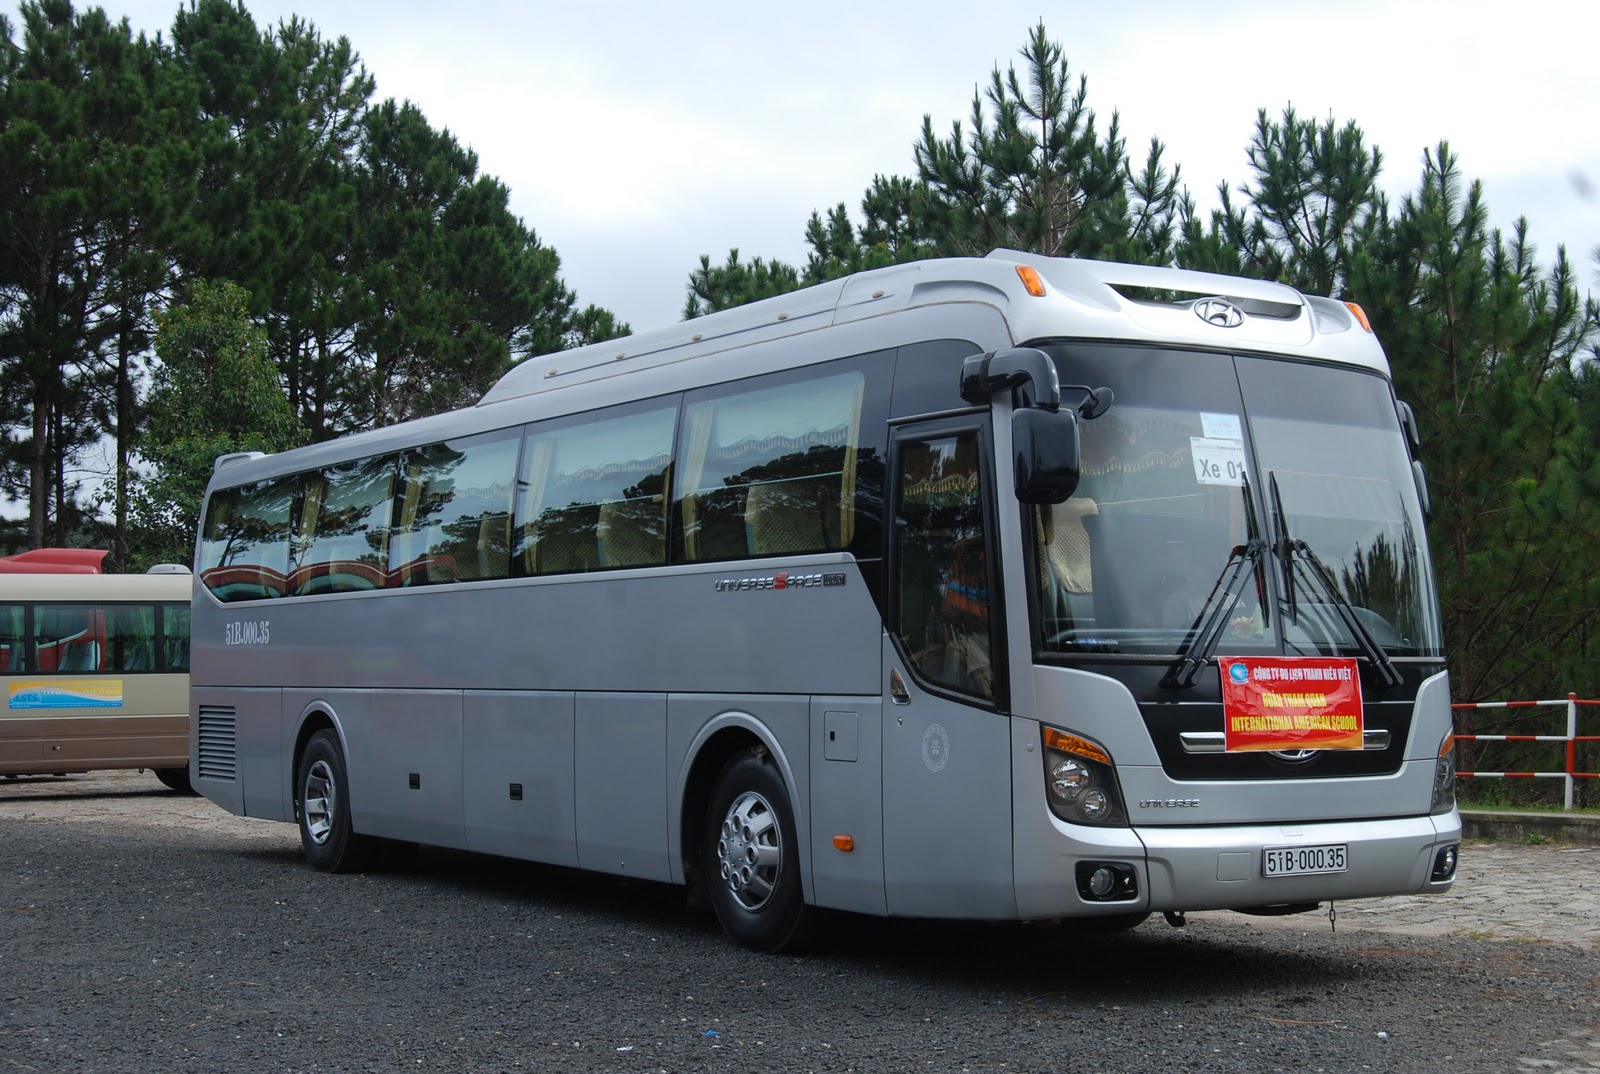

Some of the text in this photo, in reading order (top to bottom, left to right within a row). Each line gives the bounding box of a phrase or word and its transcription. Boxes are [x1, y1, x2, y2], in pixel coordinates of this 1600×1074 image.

[1199, 458, 1243, 480] Xe 01
[714, 577, 774, 592] UNIVERSE
[774, 572, 822, 590] SPACE
[225, 620, 270, 646] 51B.000.35
[1253, 665, 1271, 681] CÔNG
[1270, 667, 1279, 681] TY
[1303, 667, 1323, 681] THANH
[1338, 665, 1351, 683] VIỆT
[16, 694, 37, 702] LSTS
[1282, 693, 1304, 708] THAM
[1304, 693, 1327, 708] QUAN
[1231, 716, 1358, 732] INTERNATIONAL AMERICAN SCHOOL
[1140, 799, 1200, 808] UNIVERSE
[1268, 848, 1344, 872] 51B-000.35
